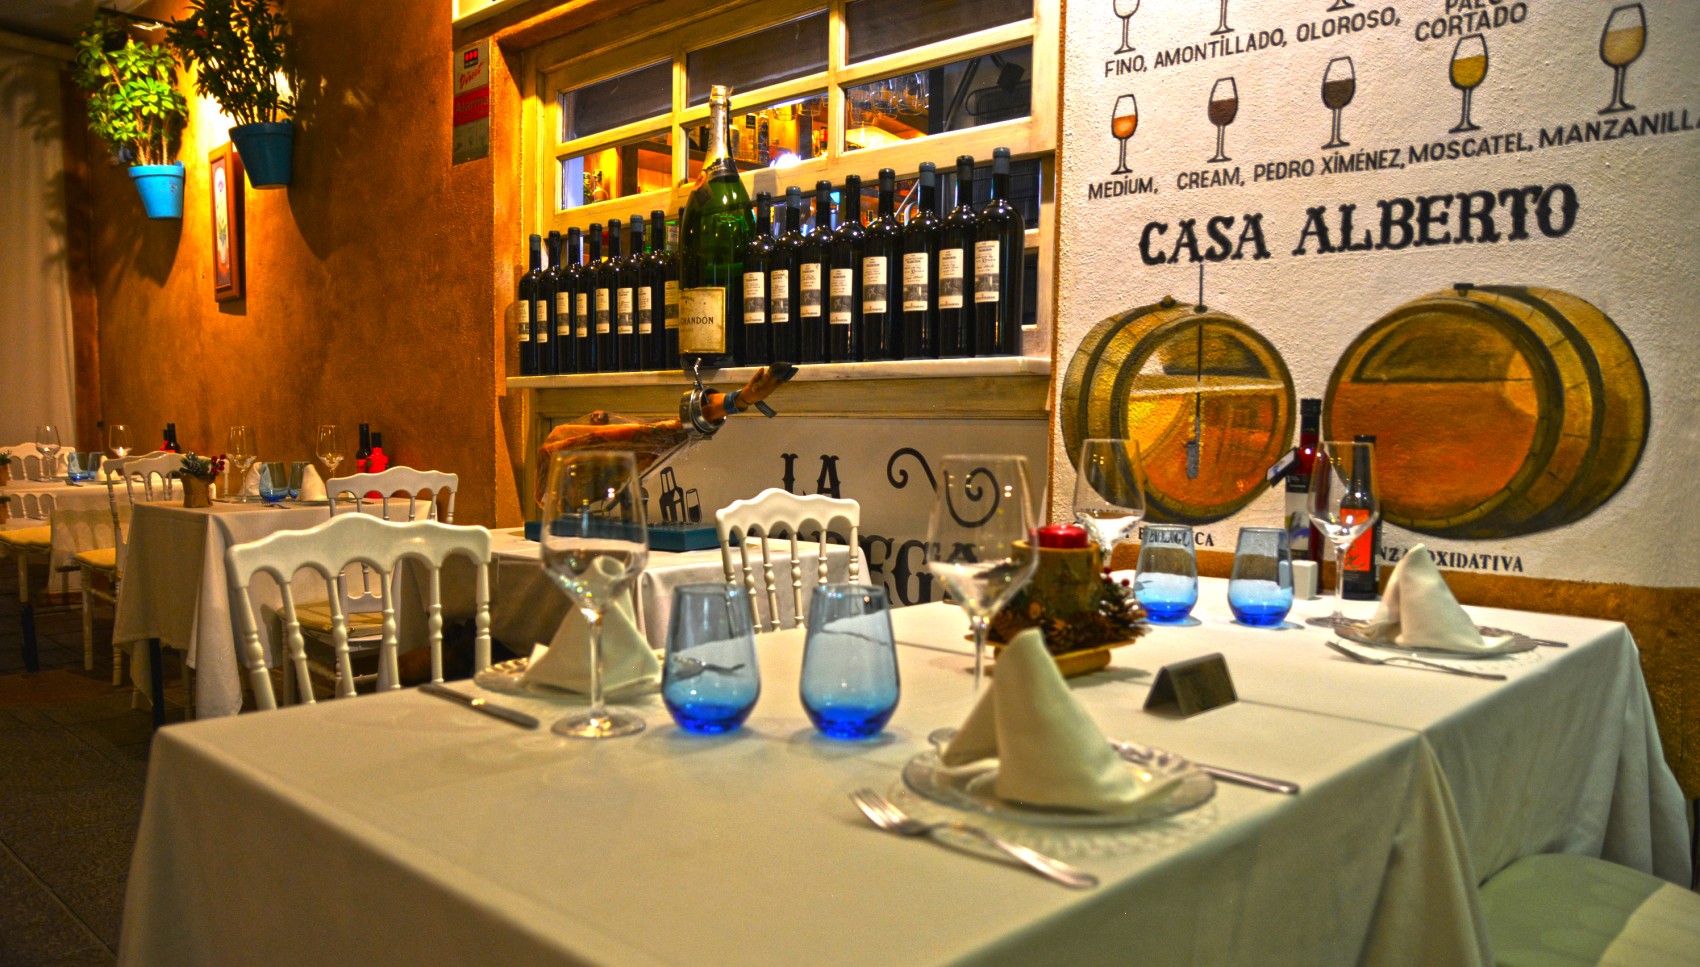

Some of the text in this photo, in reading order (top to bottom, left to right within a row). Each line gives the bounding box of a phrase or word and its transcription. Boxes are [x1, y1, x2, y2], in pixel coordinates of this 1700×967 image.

[1414, 2, 1527, 42] CORTADO
[1446, 0, 1501, 14] PAL
[1104, 7, 1401, 77] FINO, AMONTILLADO, OLOROSO,
[1088, 175, 1159, 201] MEDIUM,
[1177, 167, 1245, 190] CREAM,
[1253, 158, 1315, 182] PEDRO
[1408, 132, 1533, 164] MOSCATEL,
[1138, 183, 1580, 266] CASA ALBERTO
[780, 453, 841, 499] LA
